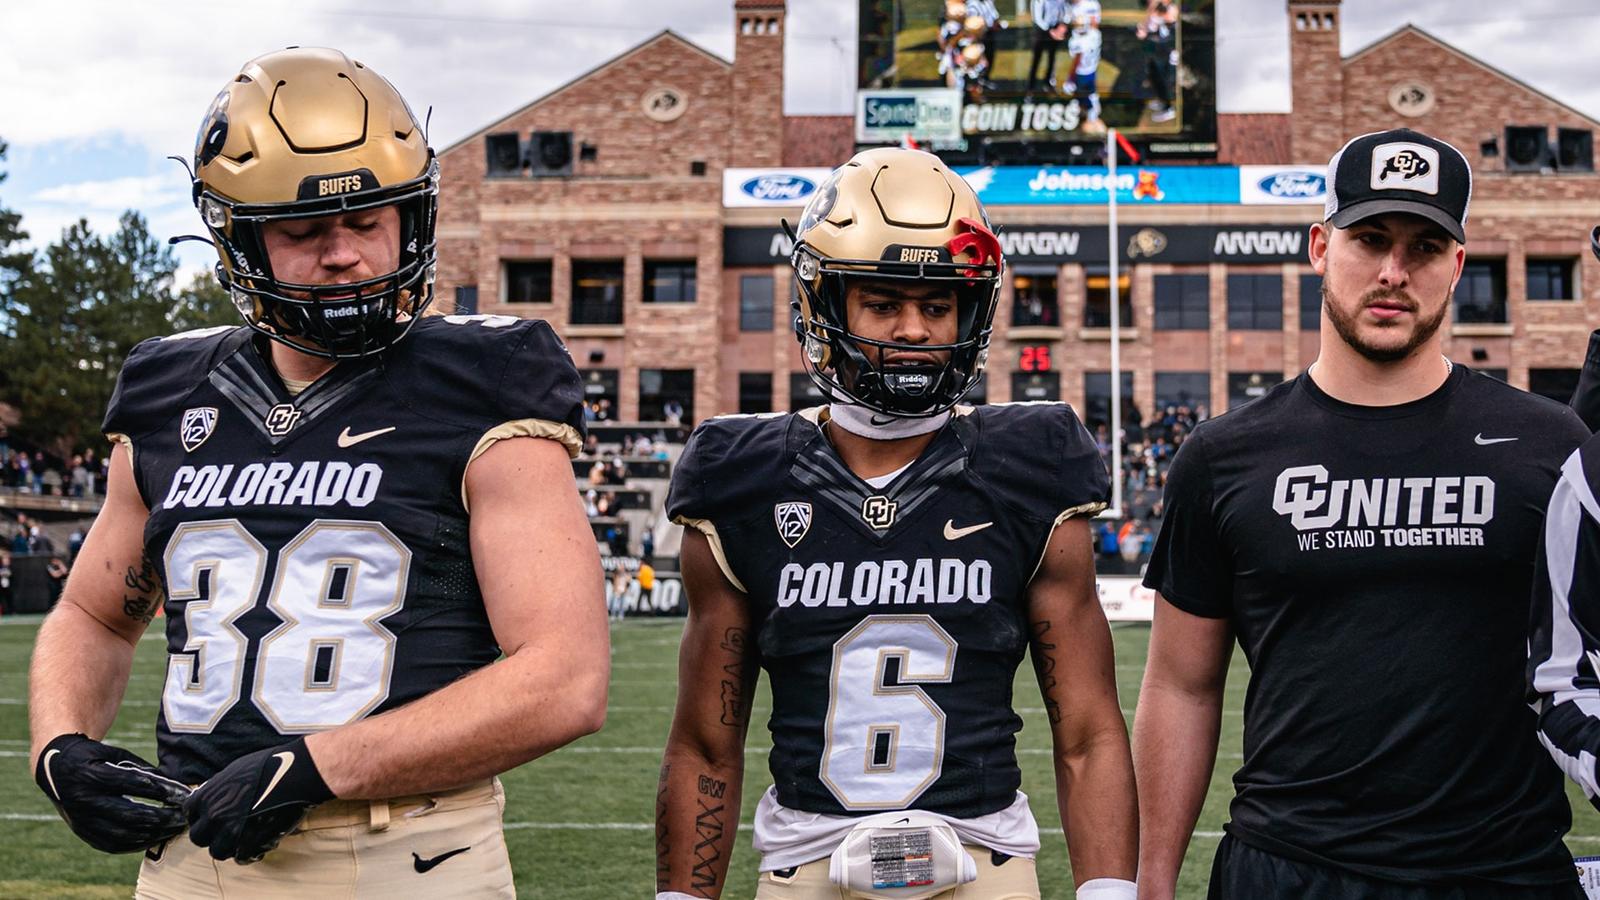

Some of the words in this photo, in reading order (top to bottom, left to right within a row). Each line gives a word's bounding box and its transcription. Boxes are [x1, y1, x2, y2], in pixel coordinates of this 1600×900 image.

[963, 103, 1016, 131] COIN
[1021, 103, 1081, 131] TOSS
[318, 175, 361, 196] BUFFS
[752, 177, 805, 199] Ford
[1270, 175, 1322, 195] Ford
[1214, 231, 1302, 255] ARROW
[900, 248, 939, 263] BUFFS
[324, 304, 368, 319] Riddel
[1020, 346, 1051, 371] 25
[183, 408, 216, 434] PAC
[185, 426, 204, 442] 12
[163, 461, 383, 509] COLORADO
[778, 503, 810, 529] PAC
[784, 521, 801, 538] 12
[1297, 532, 1319, 551] WE
[1325, 530, 1375, 549] STAND
[1380, 528, 1484, 547] TOGETHER
[776, 558, 992, 608] COLORADO
[163, 518, 412, 735] 38
[819, 614, 959, 811] 6
